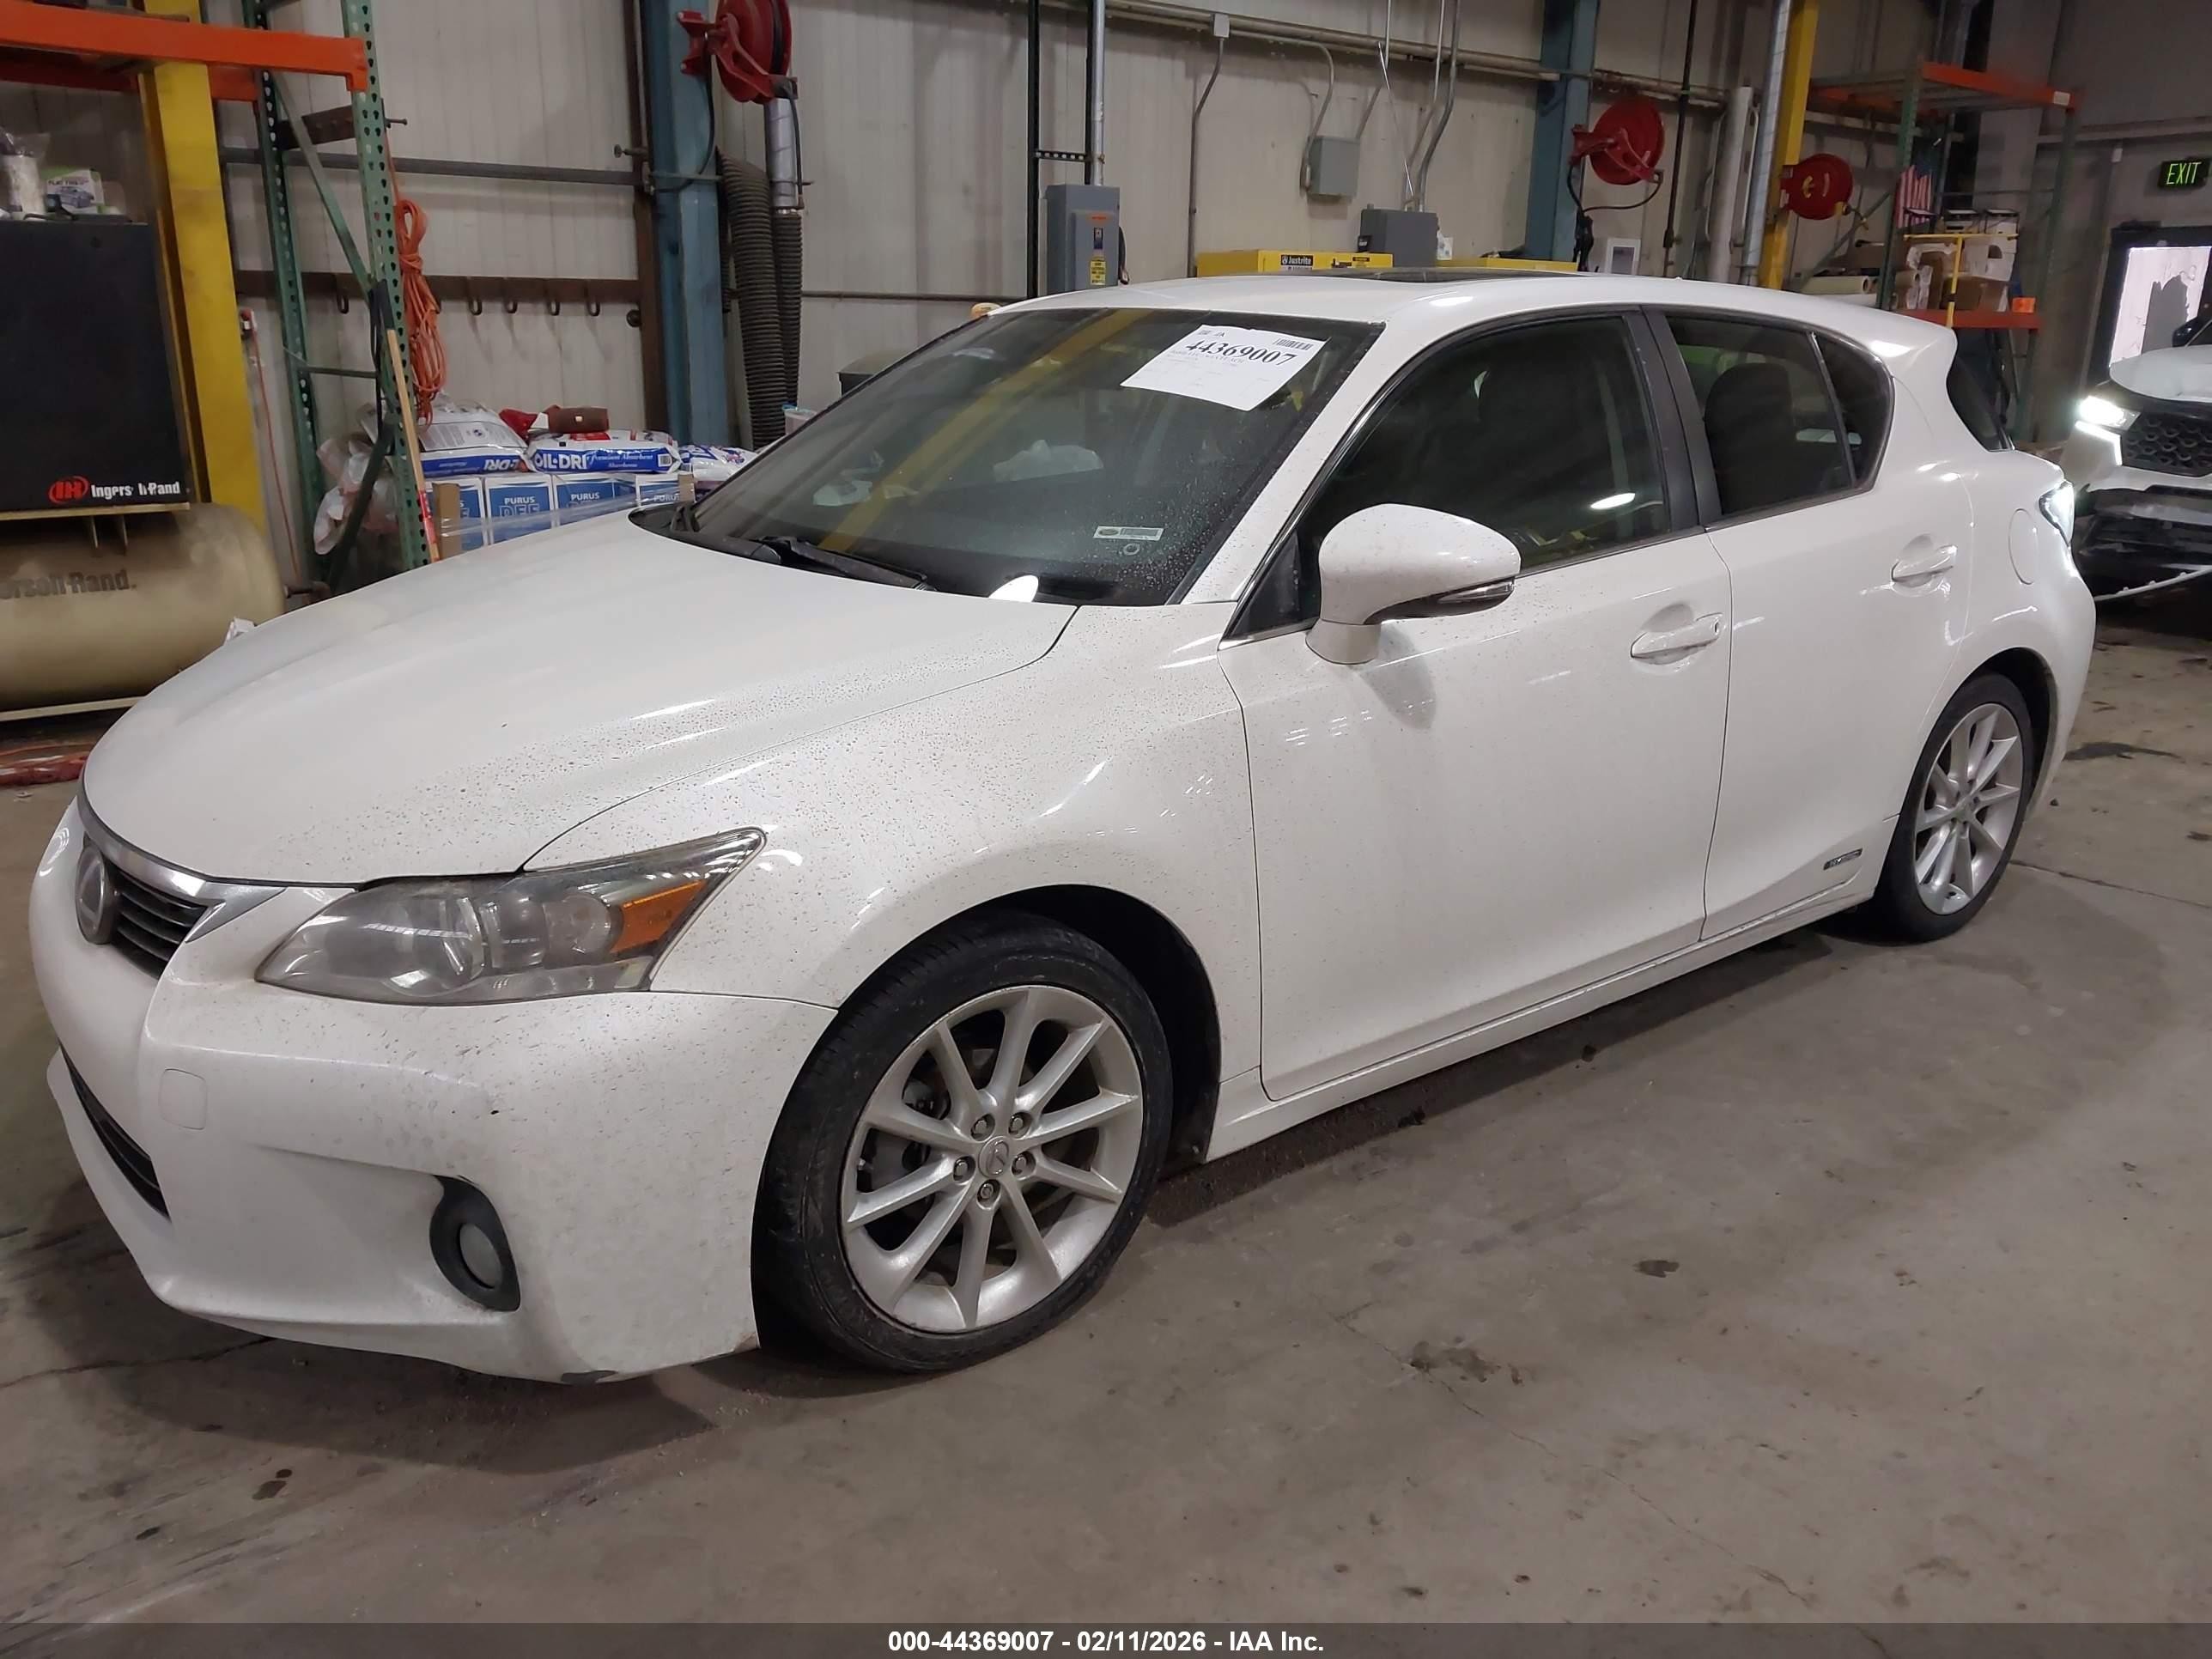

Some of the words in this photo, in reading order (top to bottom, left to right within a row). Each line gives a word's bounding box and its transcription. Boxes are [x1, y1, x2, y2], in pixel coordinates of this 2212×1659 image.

[2166, 162, 2202, 185] EXIT
[1289, 256, 1312, 265] Justrite
[1186, 340, 1297, 367] 44369007
[504, 496, 536, 505] PURUS
[570, 491, 600, 501] PURUS
